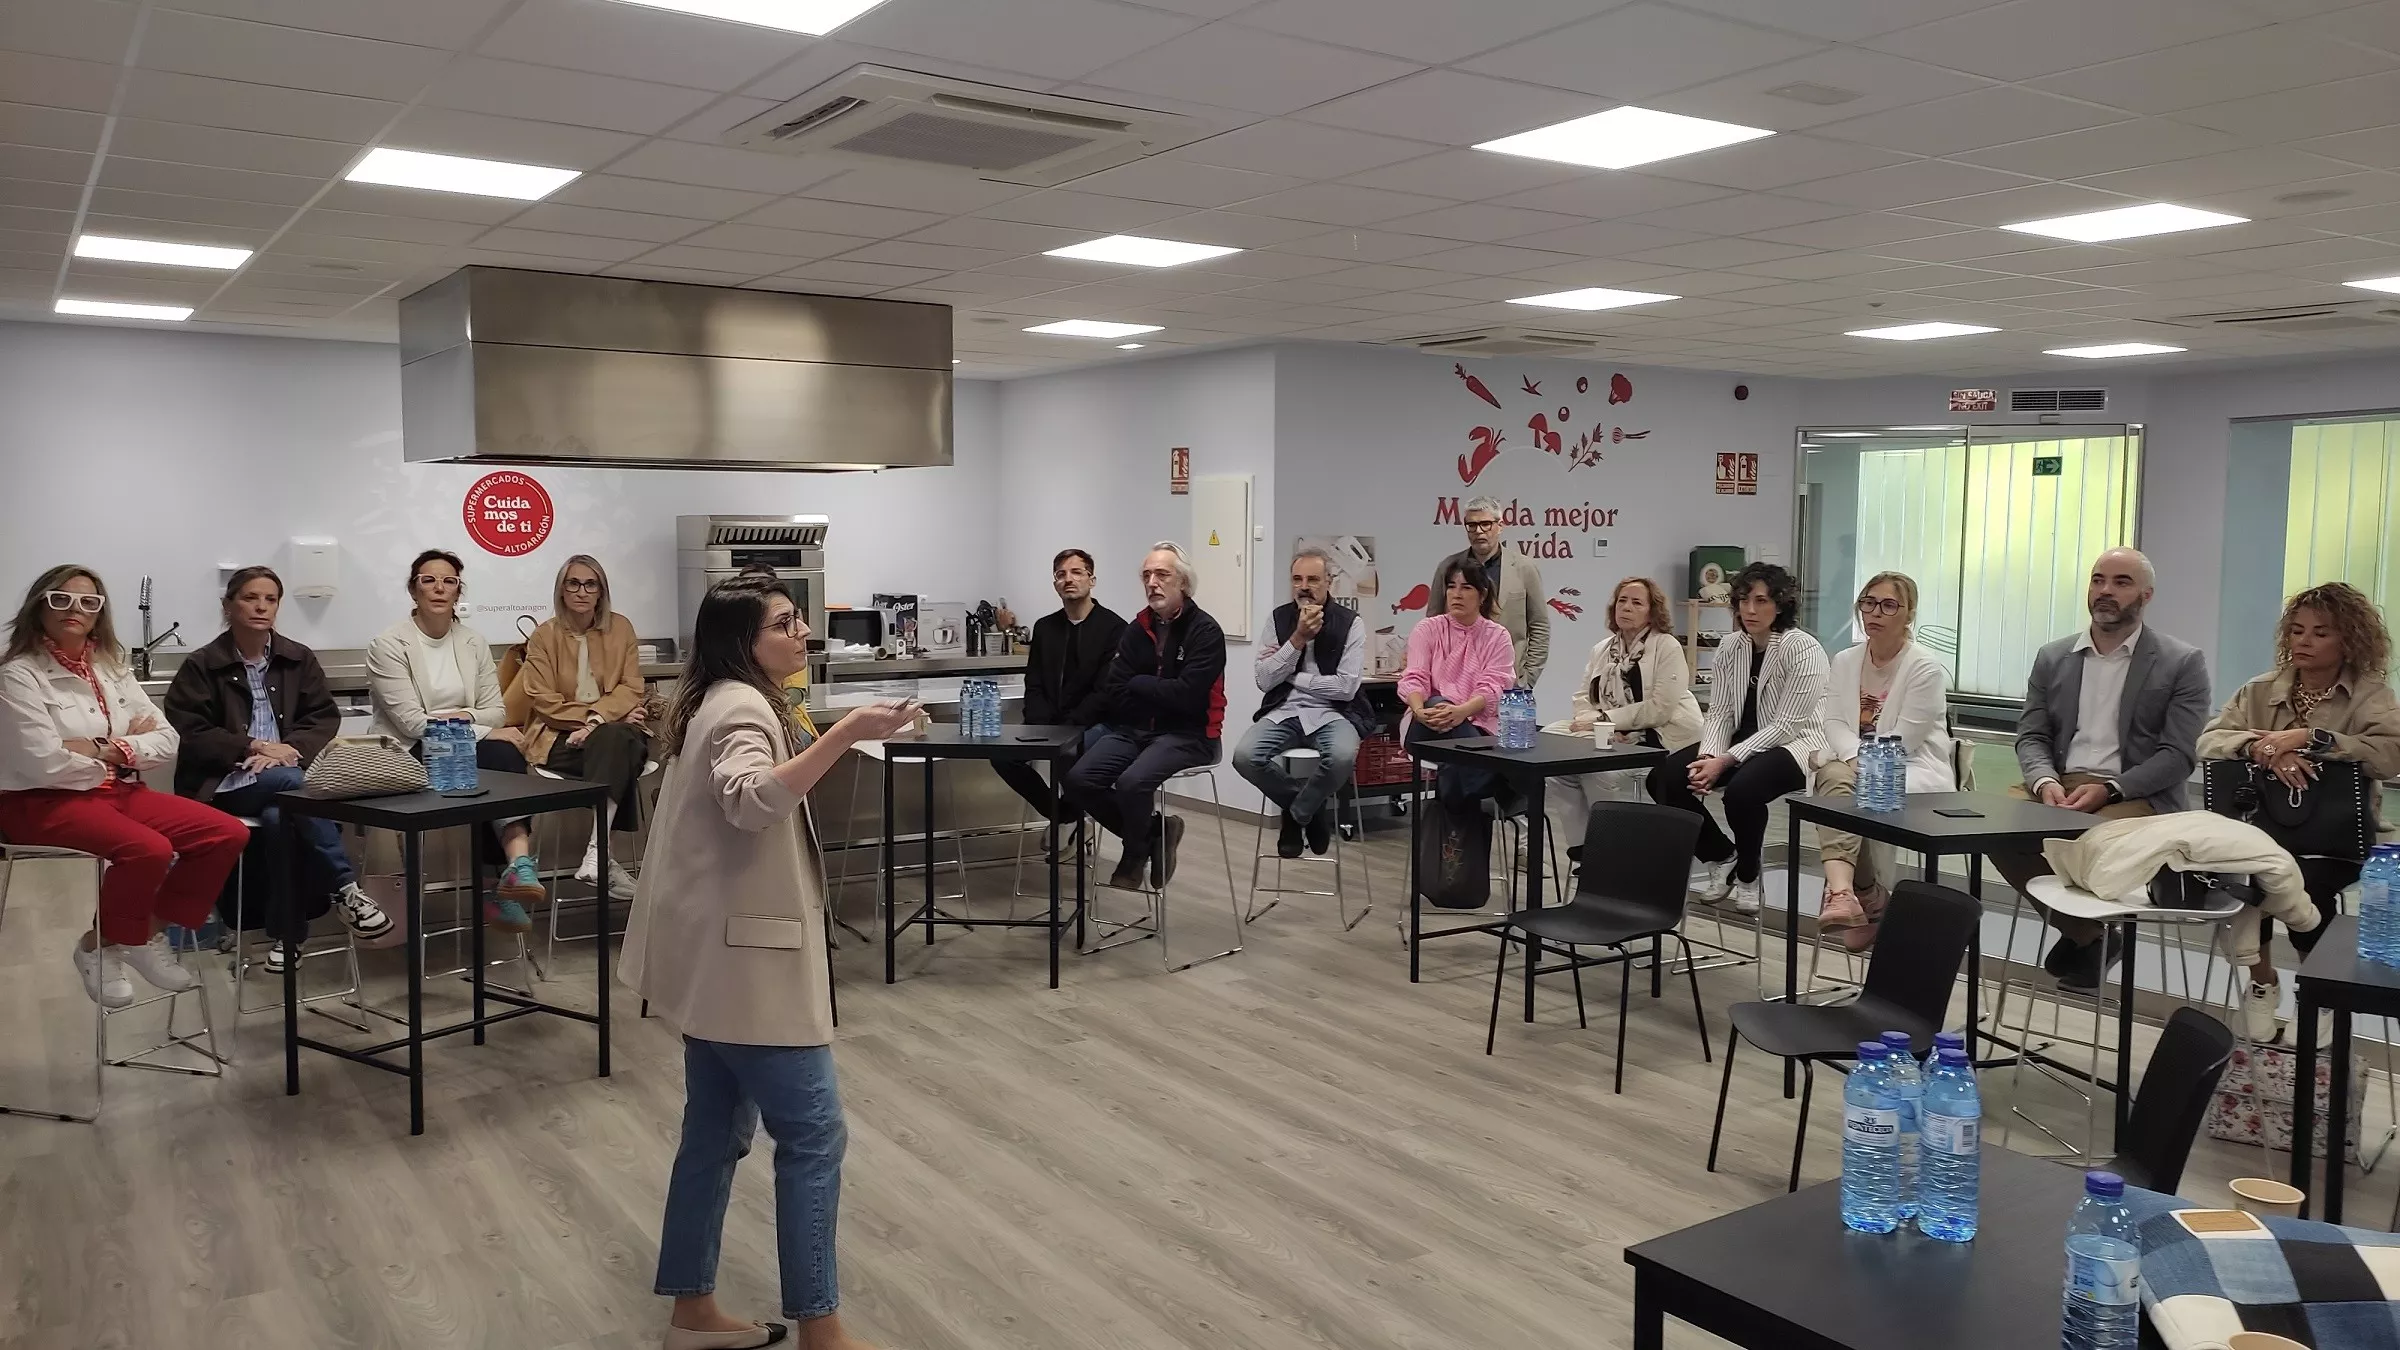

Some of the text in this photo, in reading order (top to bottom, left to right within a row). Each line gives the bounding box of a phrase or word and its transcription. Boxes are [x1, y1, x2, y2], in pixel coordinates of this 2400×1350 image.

[467, 474, 525, 523] SUPERMERCADOS
[483, 495, 531, 509] Cuida
[484, 510, 518, 520] mos
[1544, 501, 1619, 533] mejor
[496, 520, 532, 533] de ti
[504, 515, 550, 553] ALTOARAGÓN
[1517, 531, 1574, 559] vida
[476, 603, 547, 612] @superaltoaragon
[892, 602, 916, 613] Oster
